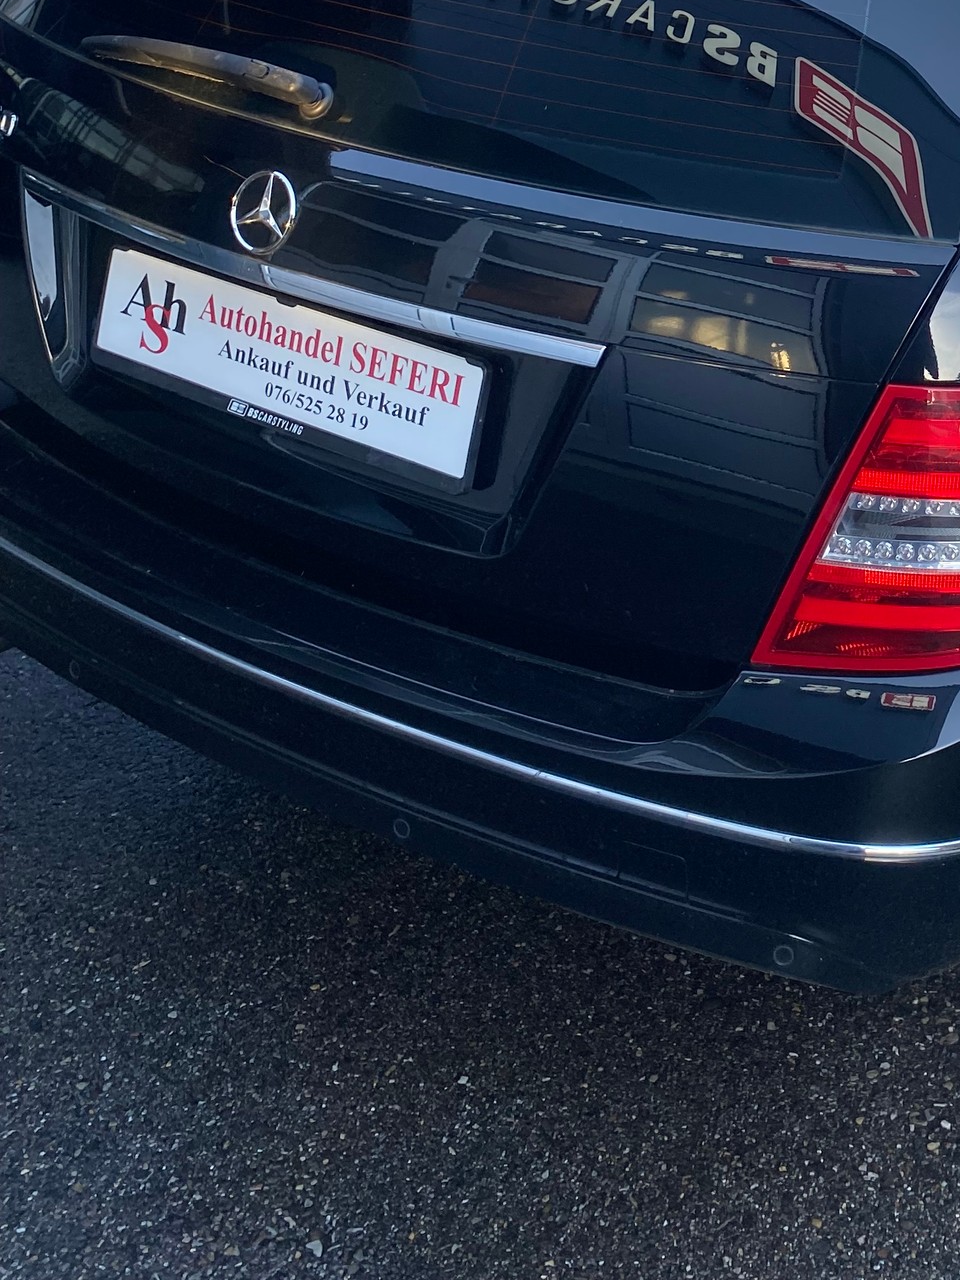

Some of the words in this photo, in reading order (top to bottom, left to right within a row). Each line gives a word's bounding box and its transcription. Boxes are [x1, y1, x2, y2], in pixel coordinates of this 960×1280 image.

[198, 293, 344, 367] Autohandel
[349, 341, 466, 408] SEFERI
[218, 339, 294, 380] Ankauf
[297, 368, 336, 396] und
[343, 378, 430, 427] Verkauf
[247, 407, 304, 436] BSCARSTYLING
[264, 382, 324, 415] 076/525
[326, 404, 346, 424] 28
[350, 413, 369, 431] 19
